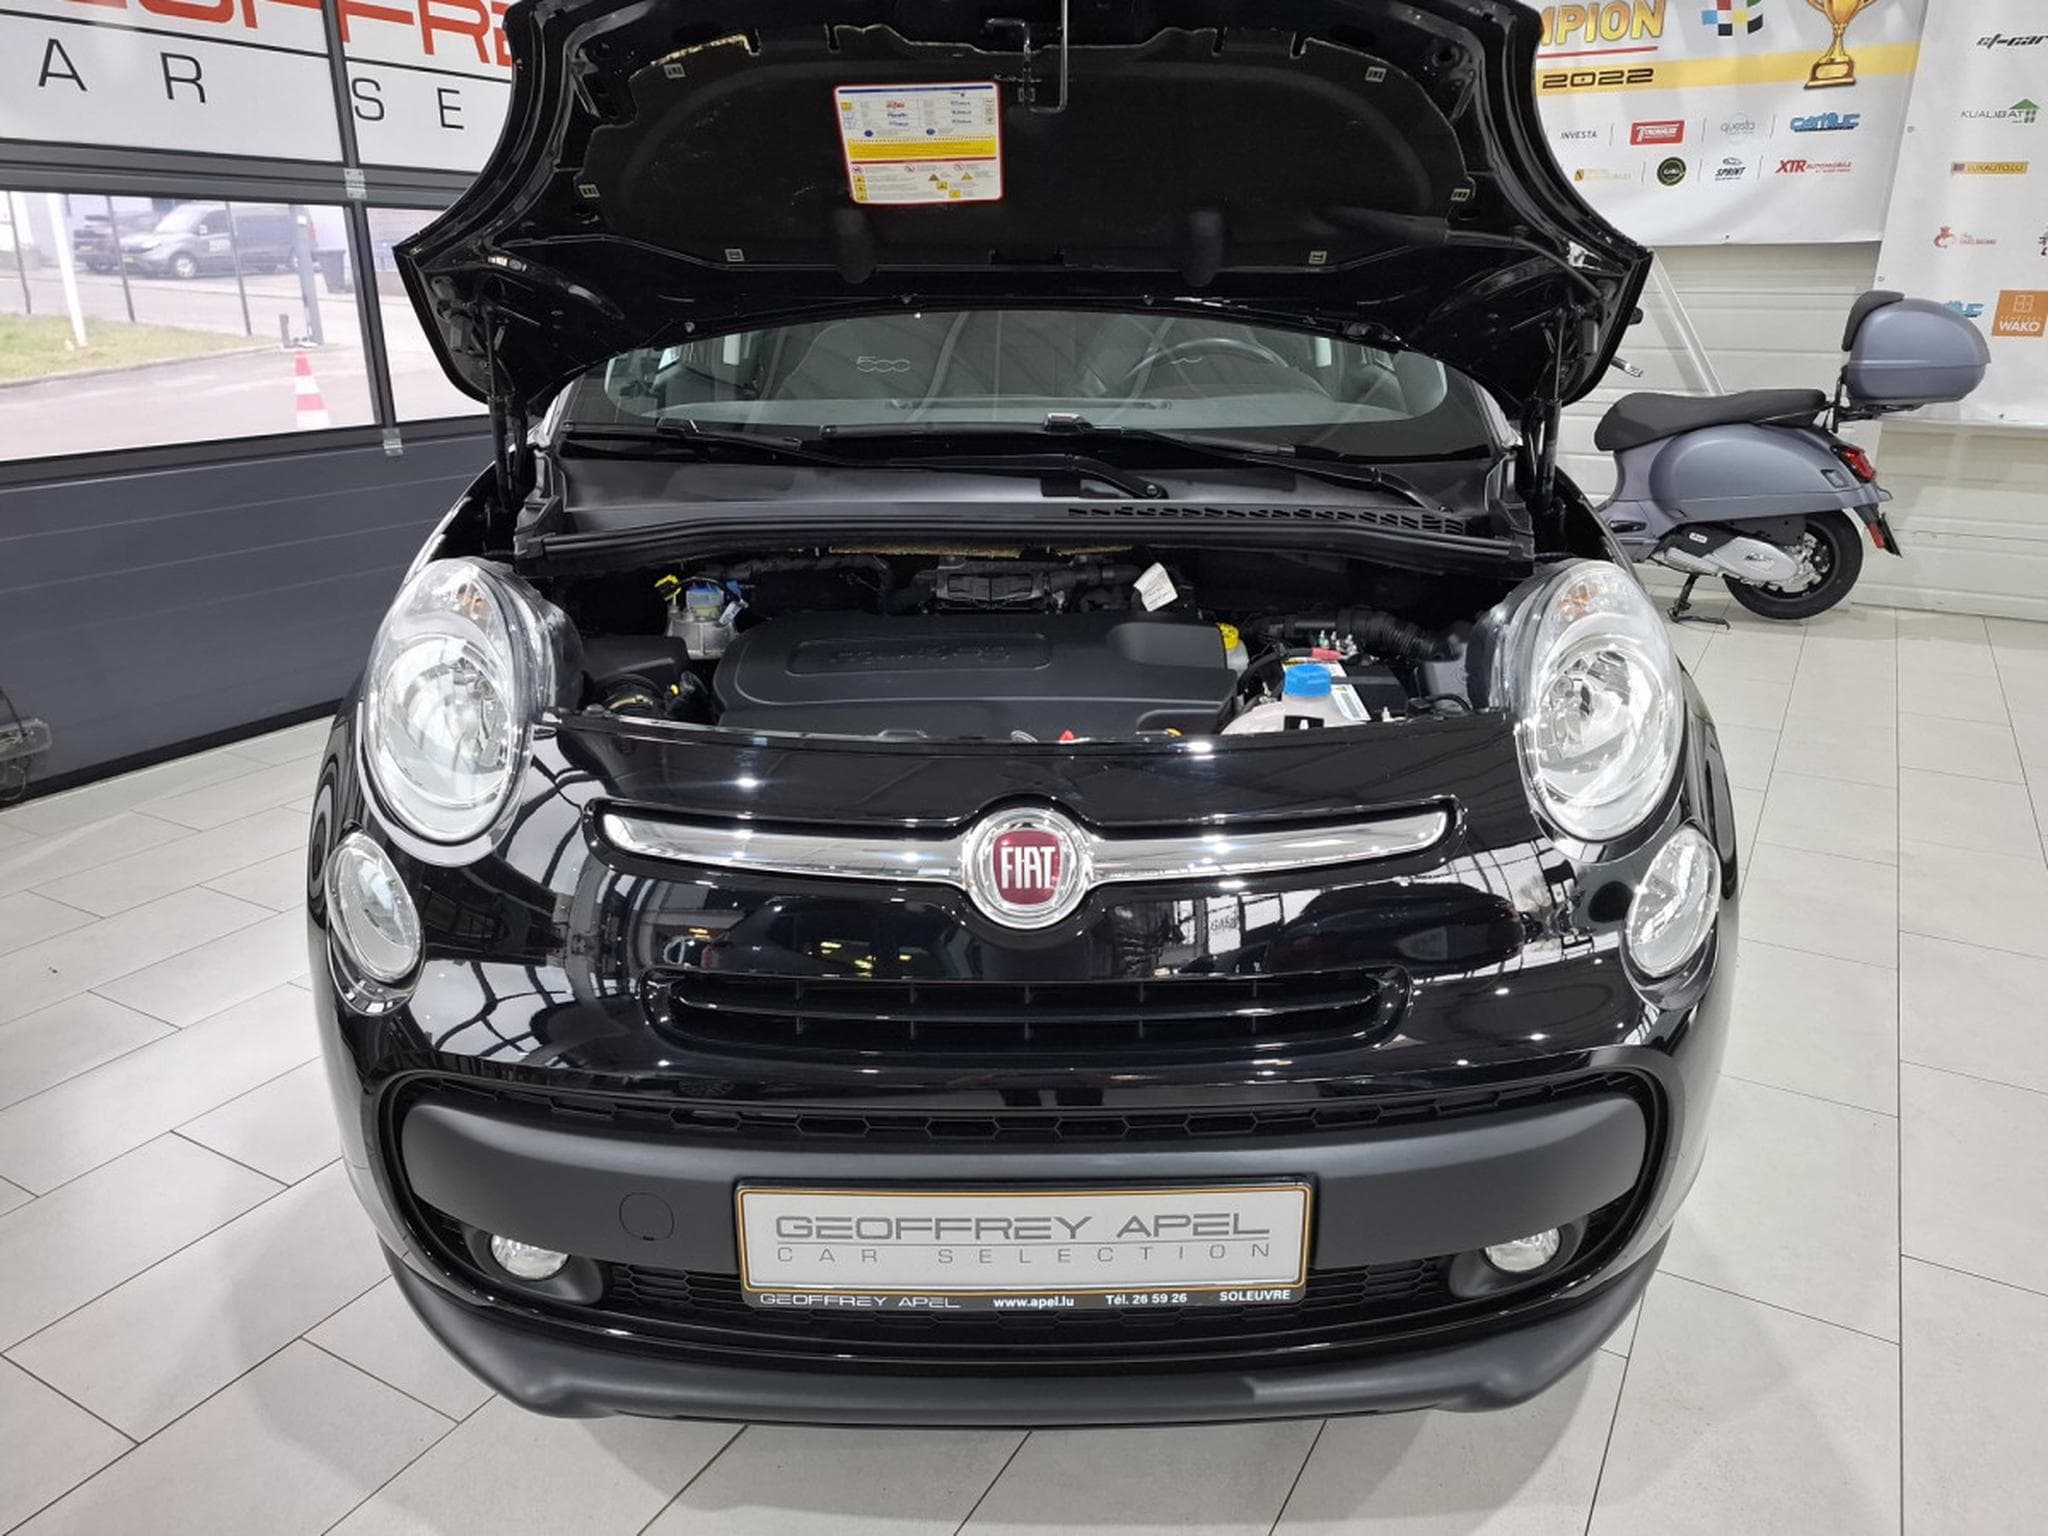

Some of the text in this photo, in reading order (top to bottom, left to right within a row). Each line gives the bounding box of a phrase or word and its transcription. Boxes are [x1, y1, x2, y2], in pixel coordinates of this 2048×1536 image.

[1542, 68, 1654, 89] 2022
[1561, 130, 1598, 140] INVESTA
[1715, 166, 1747, 177] SPRINT
[1775, 159, 1807, 174] XTR
[1999, 320, 2041, 332] WAKO
[1001, 846, 1056, 889] FIAT
[776, 1213, 1270, 1240] GEOFFREY APEL
[777, 1243, 1270, 1264] CAR SELECTION
[760, 1290, 1290, 1310] GEOFFREY APEL www.apel.lu Tél. 26 59 26 SOLEUVRE
